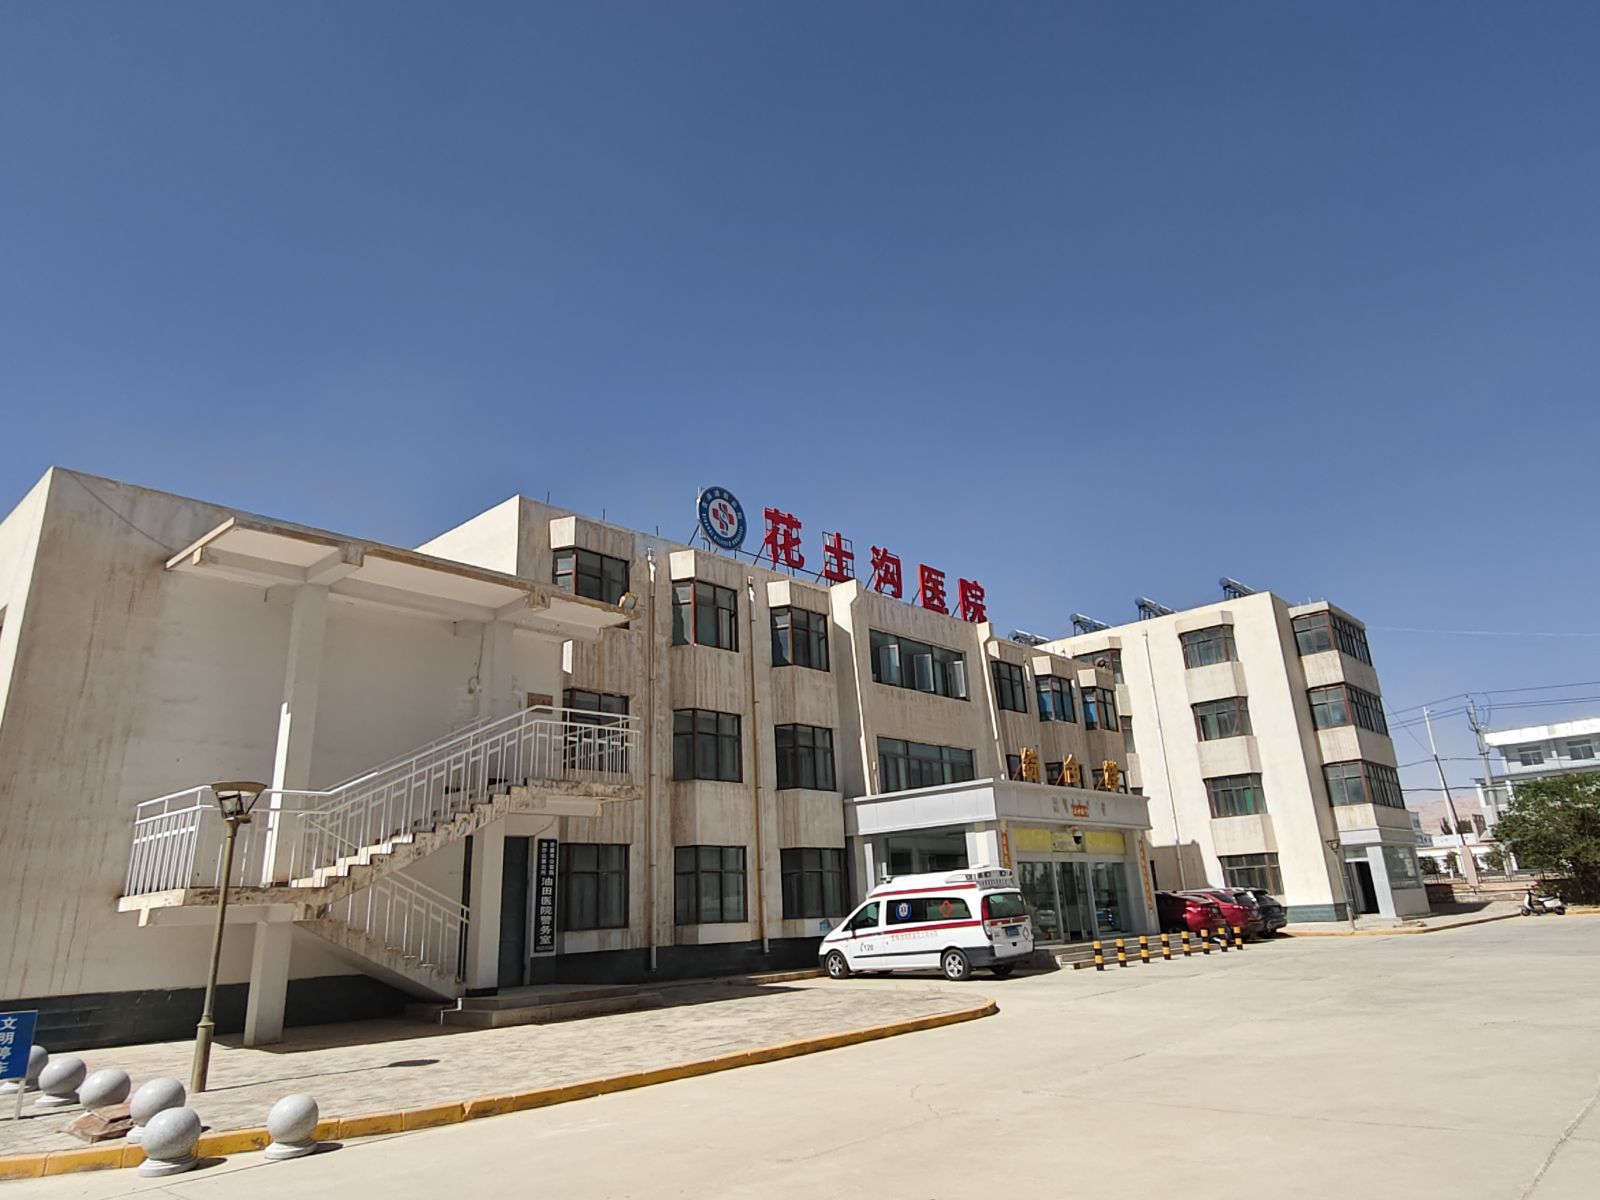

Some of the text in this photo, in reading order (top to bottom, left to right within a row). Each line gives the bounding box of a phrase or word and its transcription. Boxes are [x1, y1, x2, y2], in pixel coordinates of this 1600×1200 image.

[763, 507, 989, 623] 花土沟医院
[540, 877, 553, 945] 油田医院警务室
